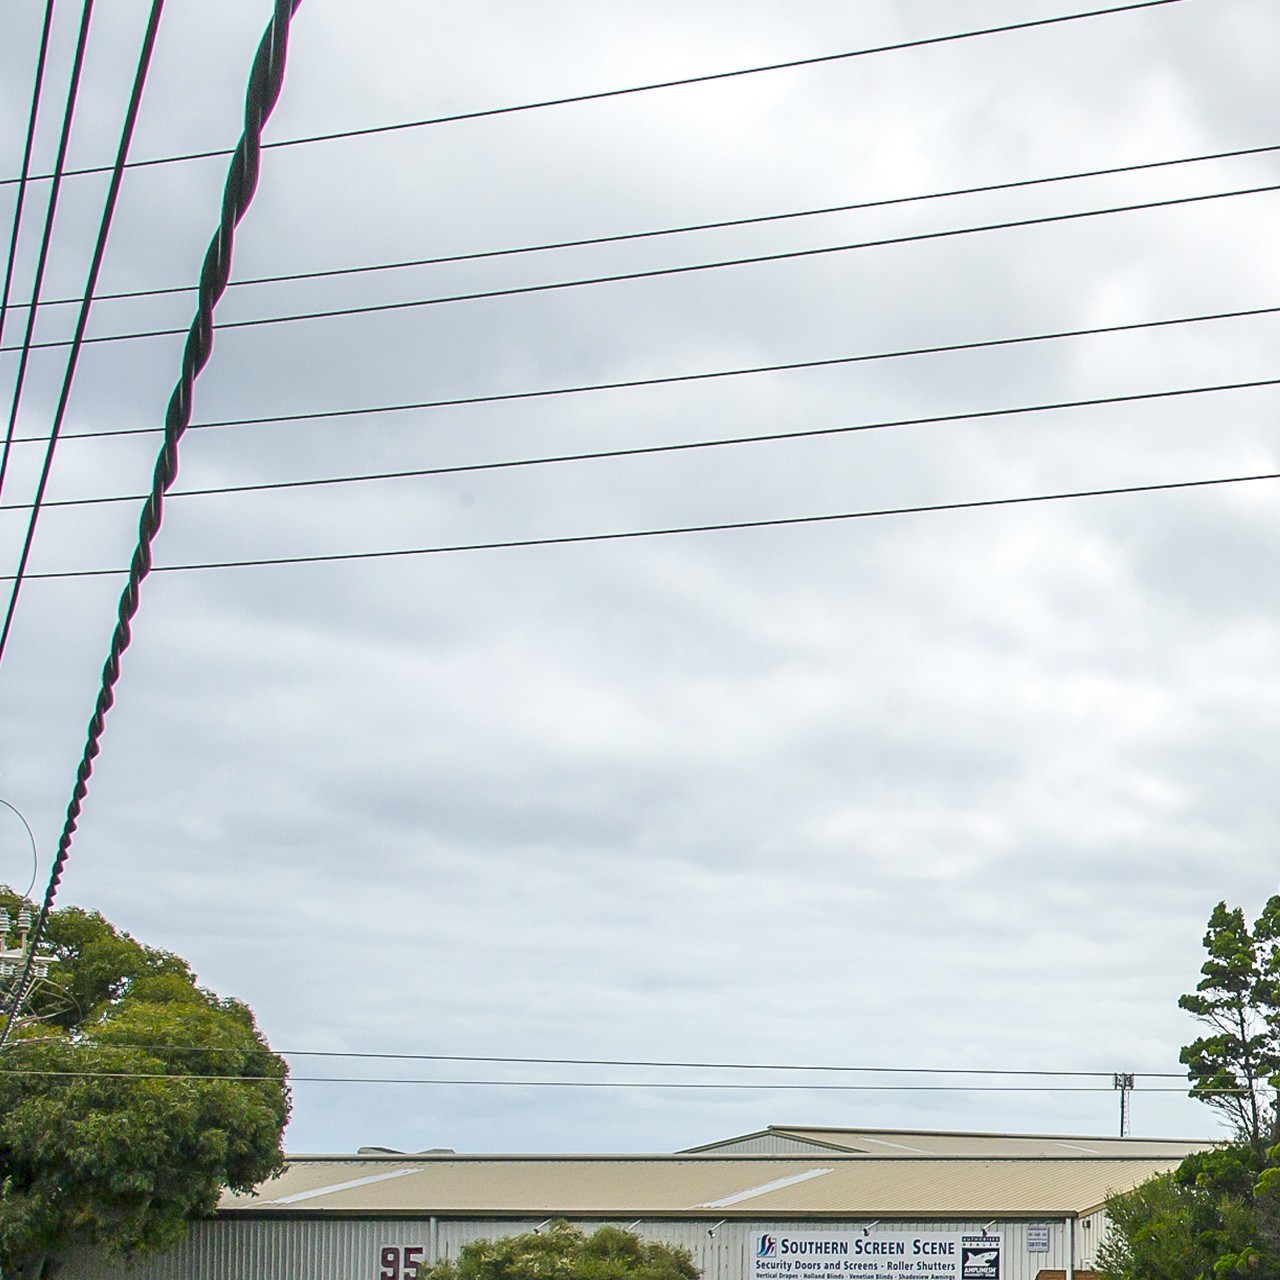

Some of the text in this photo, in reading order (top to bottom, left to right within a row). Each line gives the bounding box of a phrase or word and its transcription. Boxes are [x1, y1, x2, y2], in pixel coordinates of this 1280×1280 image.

[781, 1238, 955, 1255] SOUTHERN SCREEN SCENE
[756, 1260, 792, 1271] Security
[795, 1260, 821, 1270] Doors
[824, 1260, 841, 1270] and
[843, 1260, 878, 1271] Screens
[887, 1261, 914, 1270] Roller
[916, 1261, 956, 1271] Shutters
